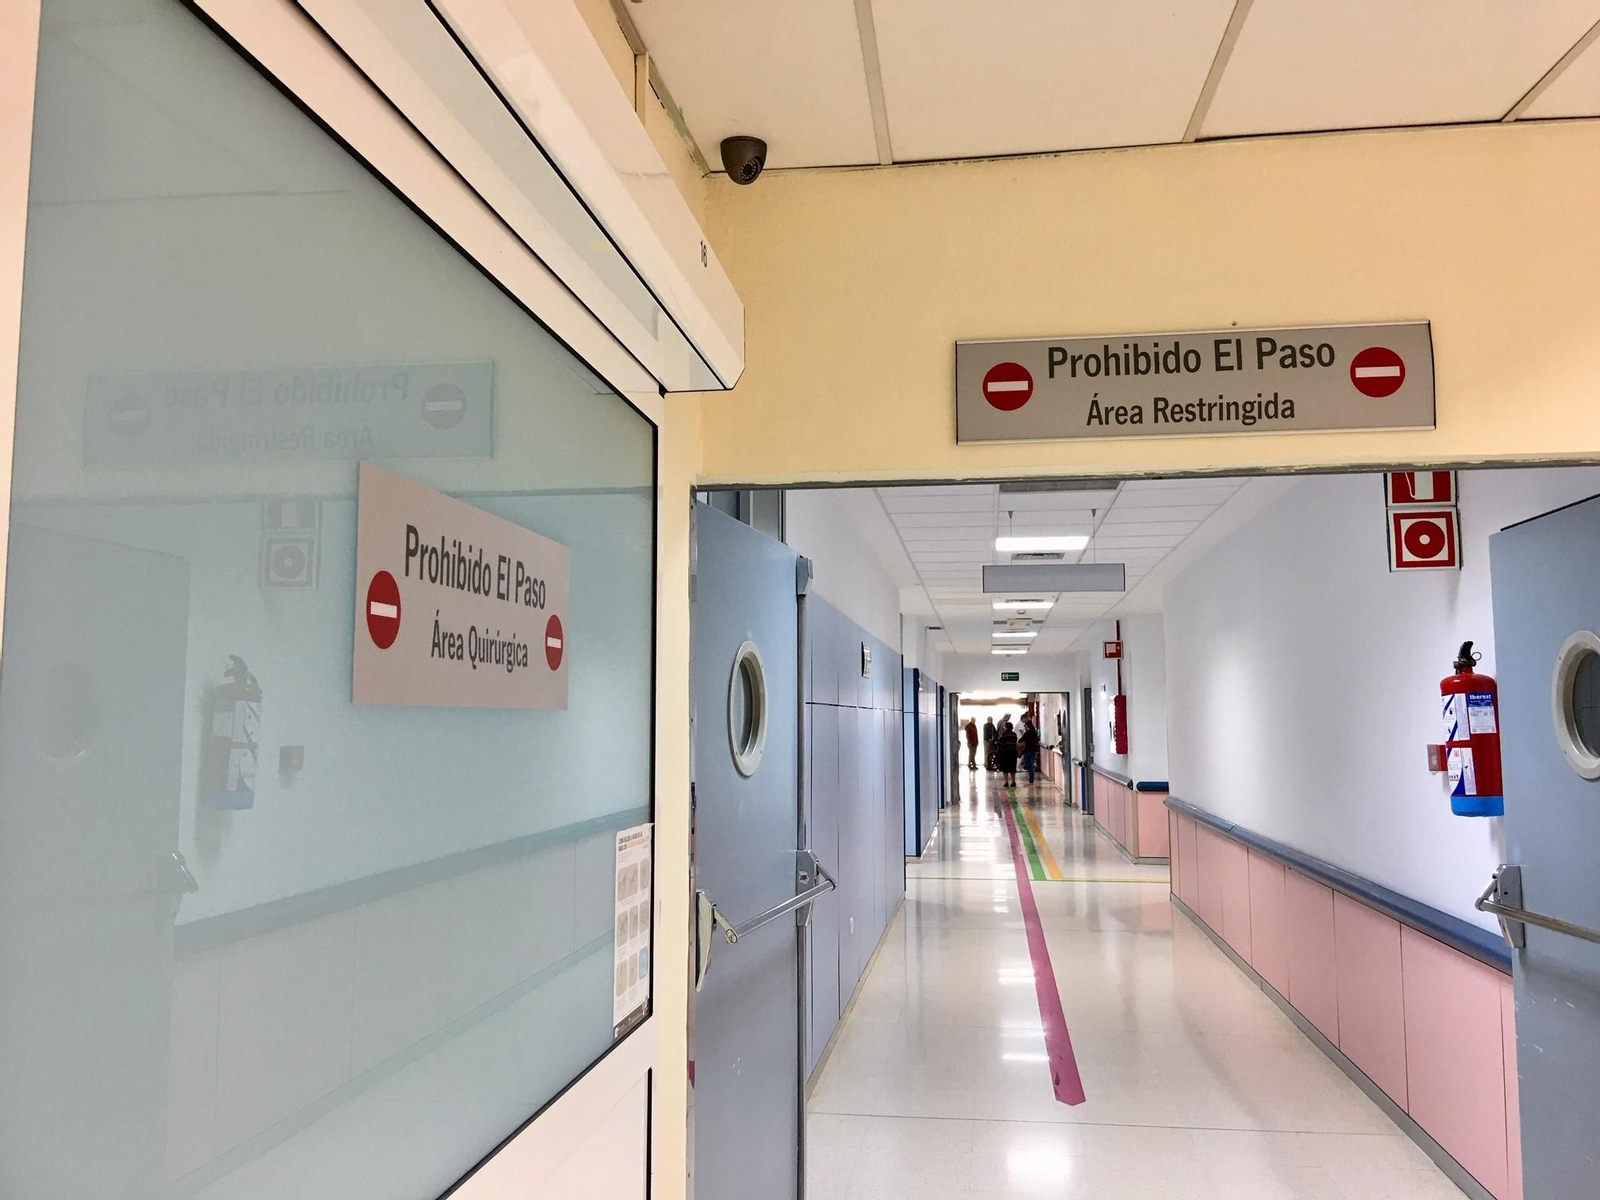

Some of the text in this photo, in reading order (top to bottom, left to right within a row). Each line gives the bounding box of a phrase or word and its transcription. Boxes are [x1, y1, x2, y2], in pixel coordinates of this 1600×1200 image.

[700, 240, 708, 268] 16
[1048, 337, 1335, 379] Prohibido El Paso
[1086, 392, 1295, 426] Área Restringida
[405, 524, 546, 610] Prohibido El Paso
[431, 609, 528, 673] Área Quirúrgica
